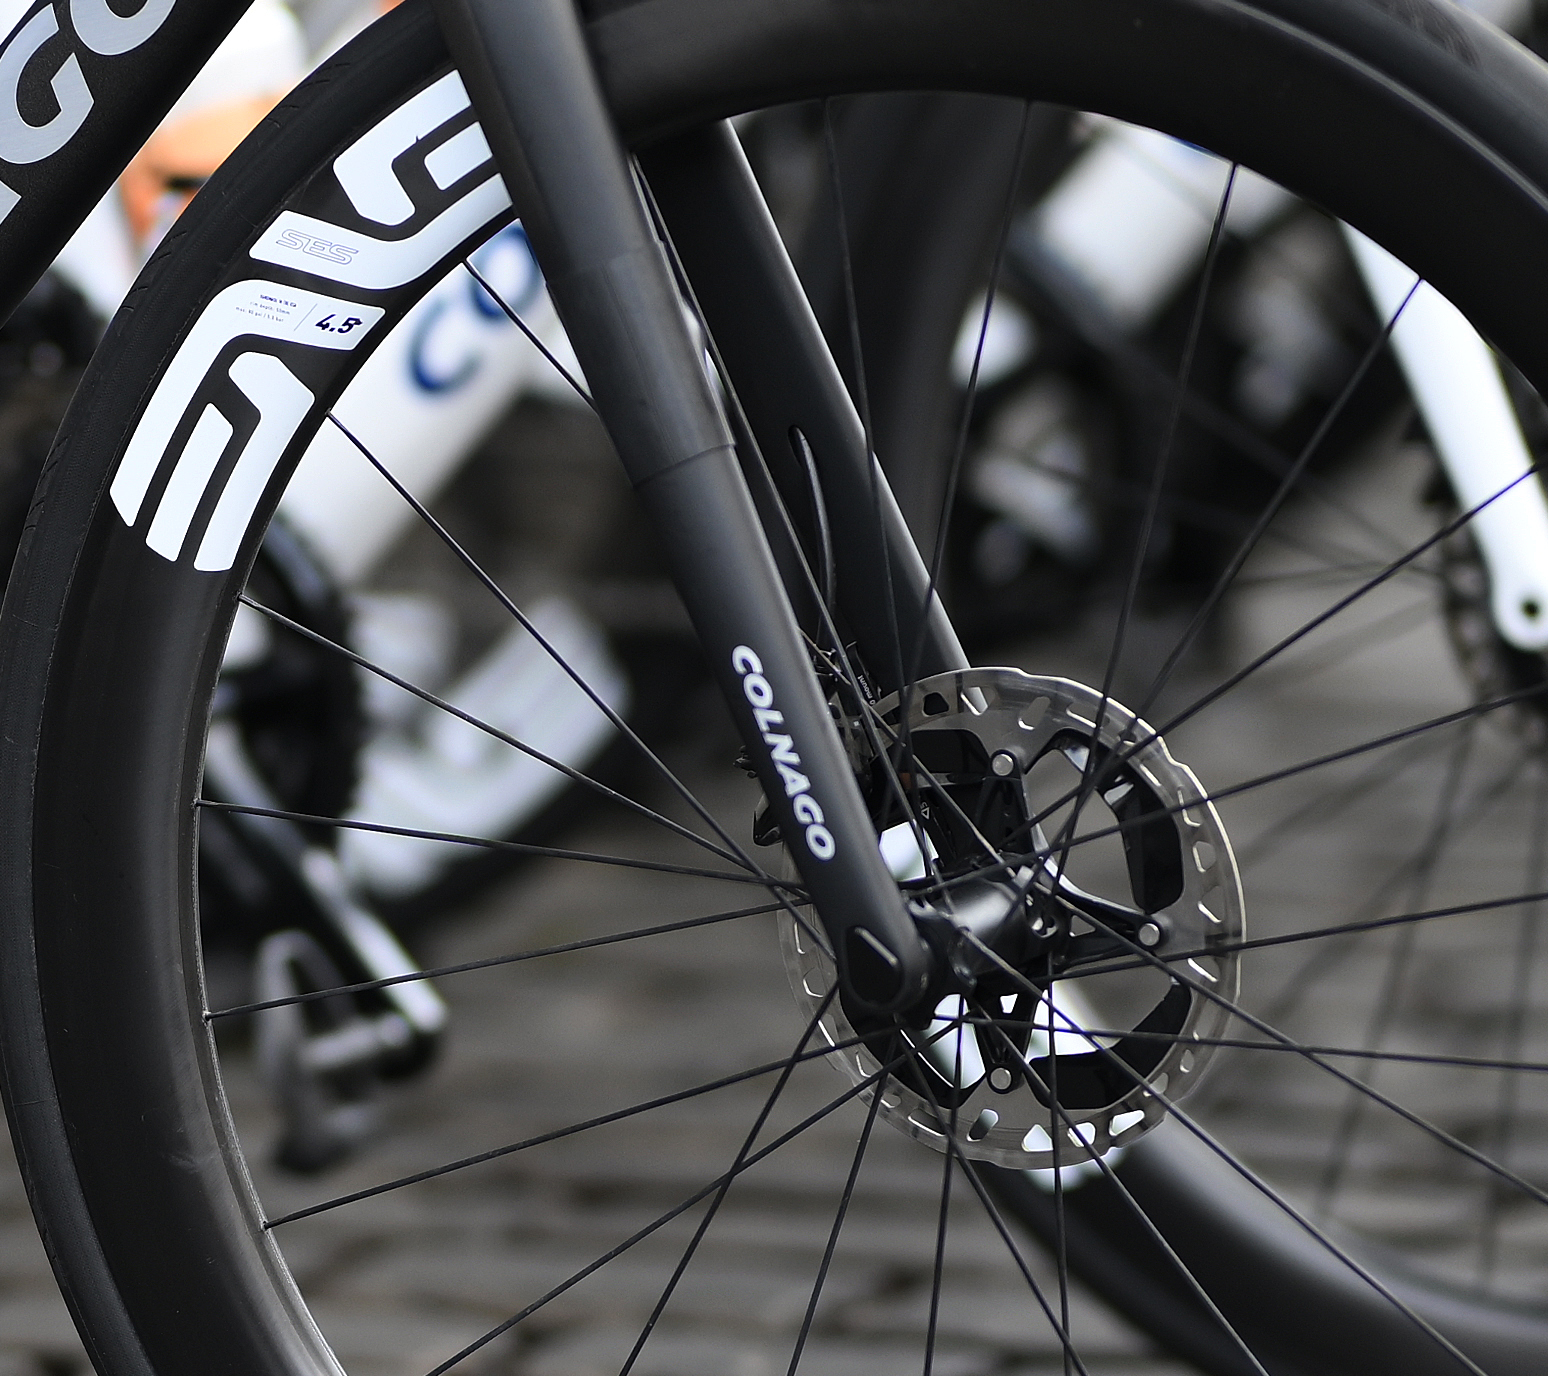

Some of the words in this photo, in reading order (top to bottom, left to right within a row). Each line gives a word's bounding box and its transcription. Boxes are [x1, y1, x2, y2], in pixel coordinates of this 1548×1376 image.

[276, 228, 359, 265] SES
[110, 70, 513, 572] ENVE
[315, 314, 363, 334] 4.5
[732, 645, 835, 861] COLNAGO
